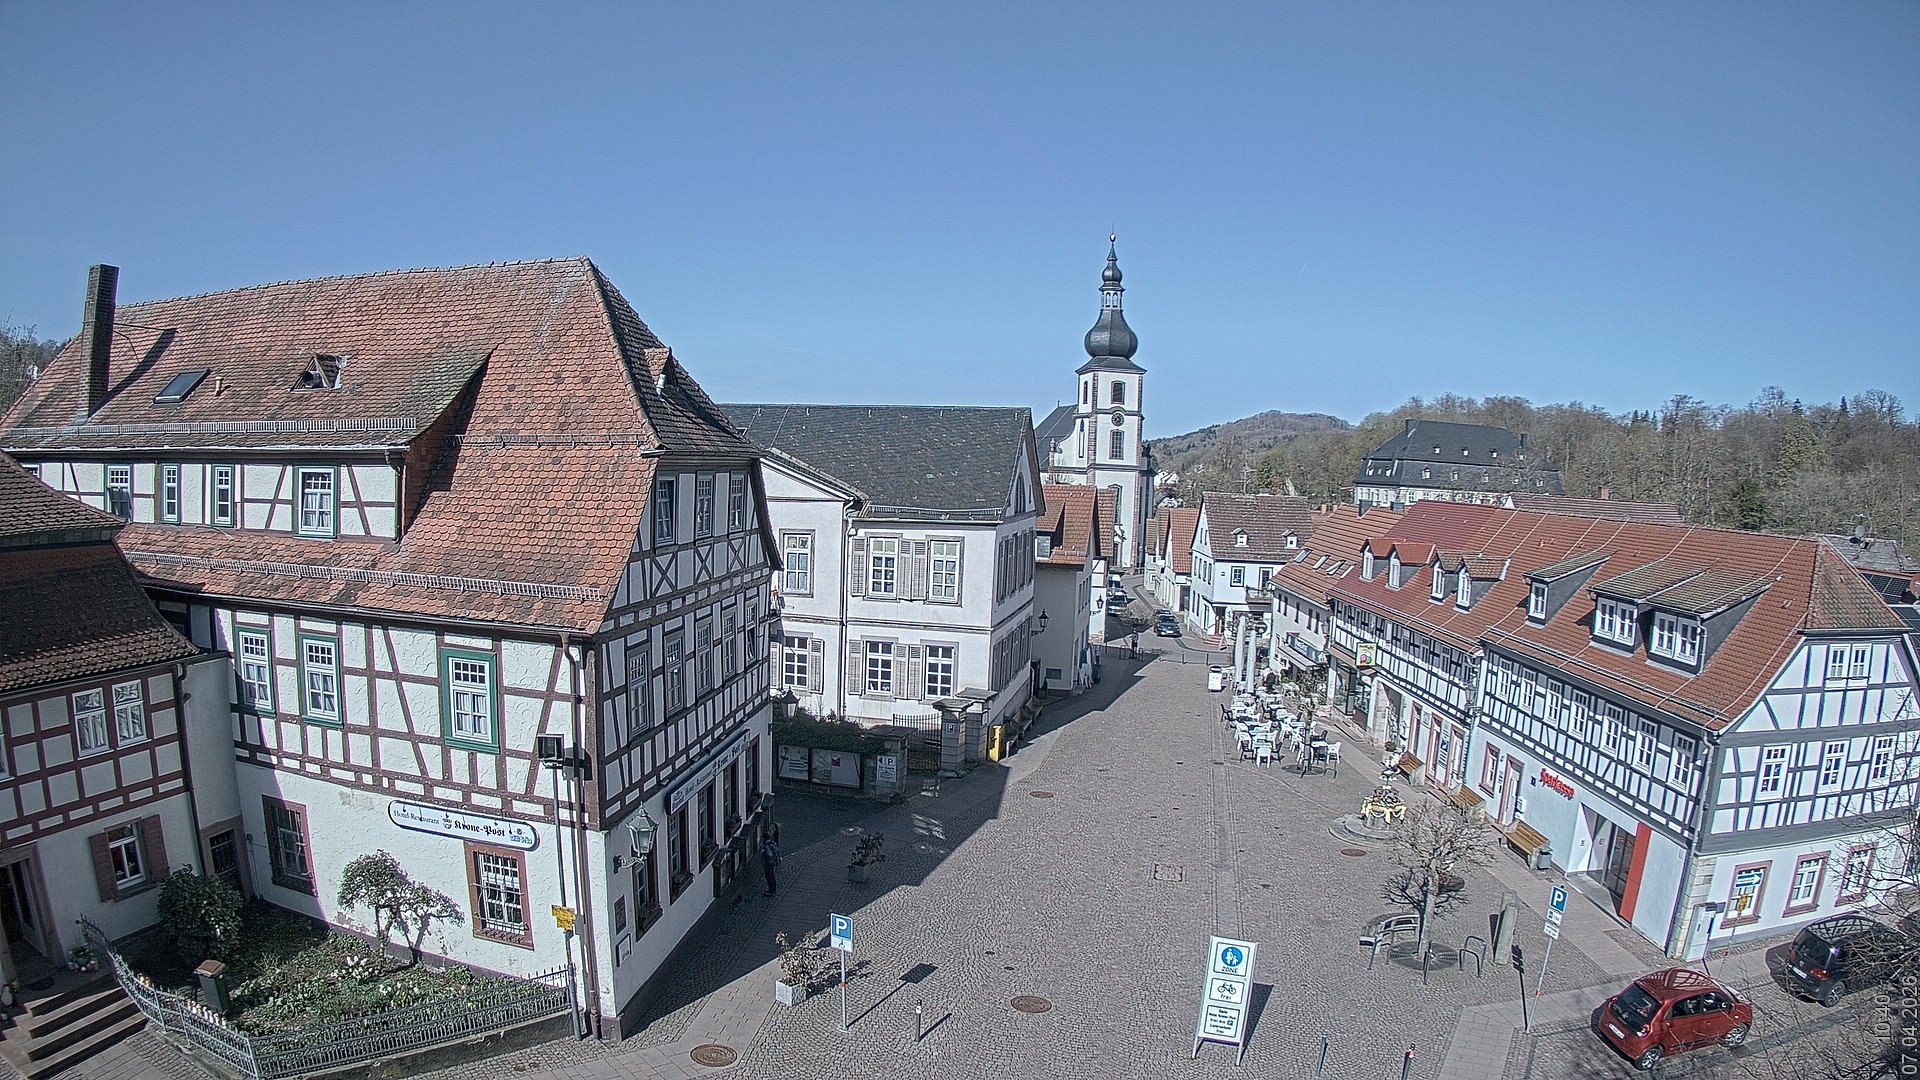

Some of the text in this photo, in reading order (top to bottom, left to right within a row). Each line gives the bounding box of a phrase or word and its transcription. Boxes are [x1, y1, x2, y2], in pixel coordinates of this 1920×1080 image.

[1540, 768, 1575, 797] Sparkasse
[454, 820, 506, 837] Krone-Post
[1553, 891, 1563, 906] P
[836, 918, 847, 934] P
